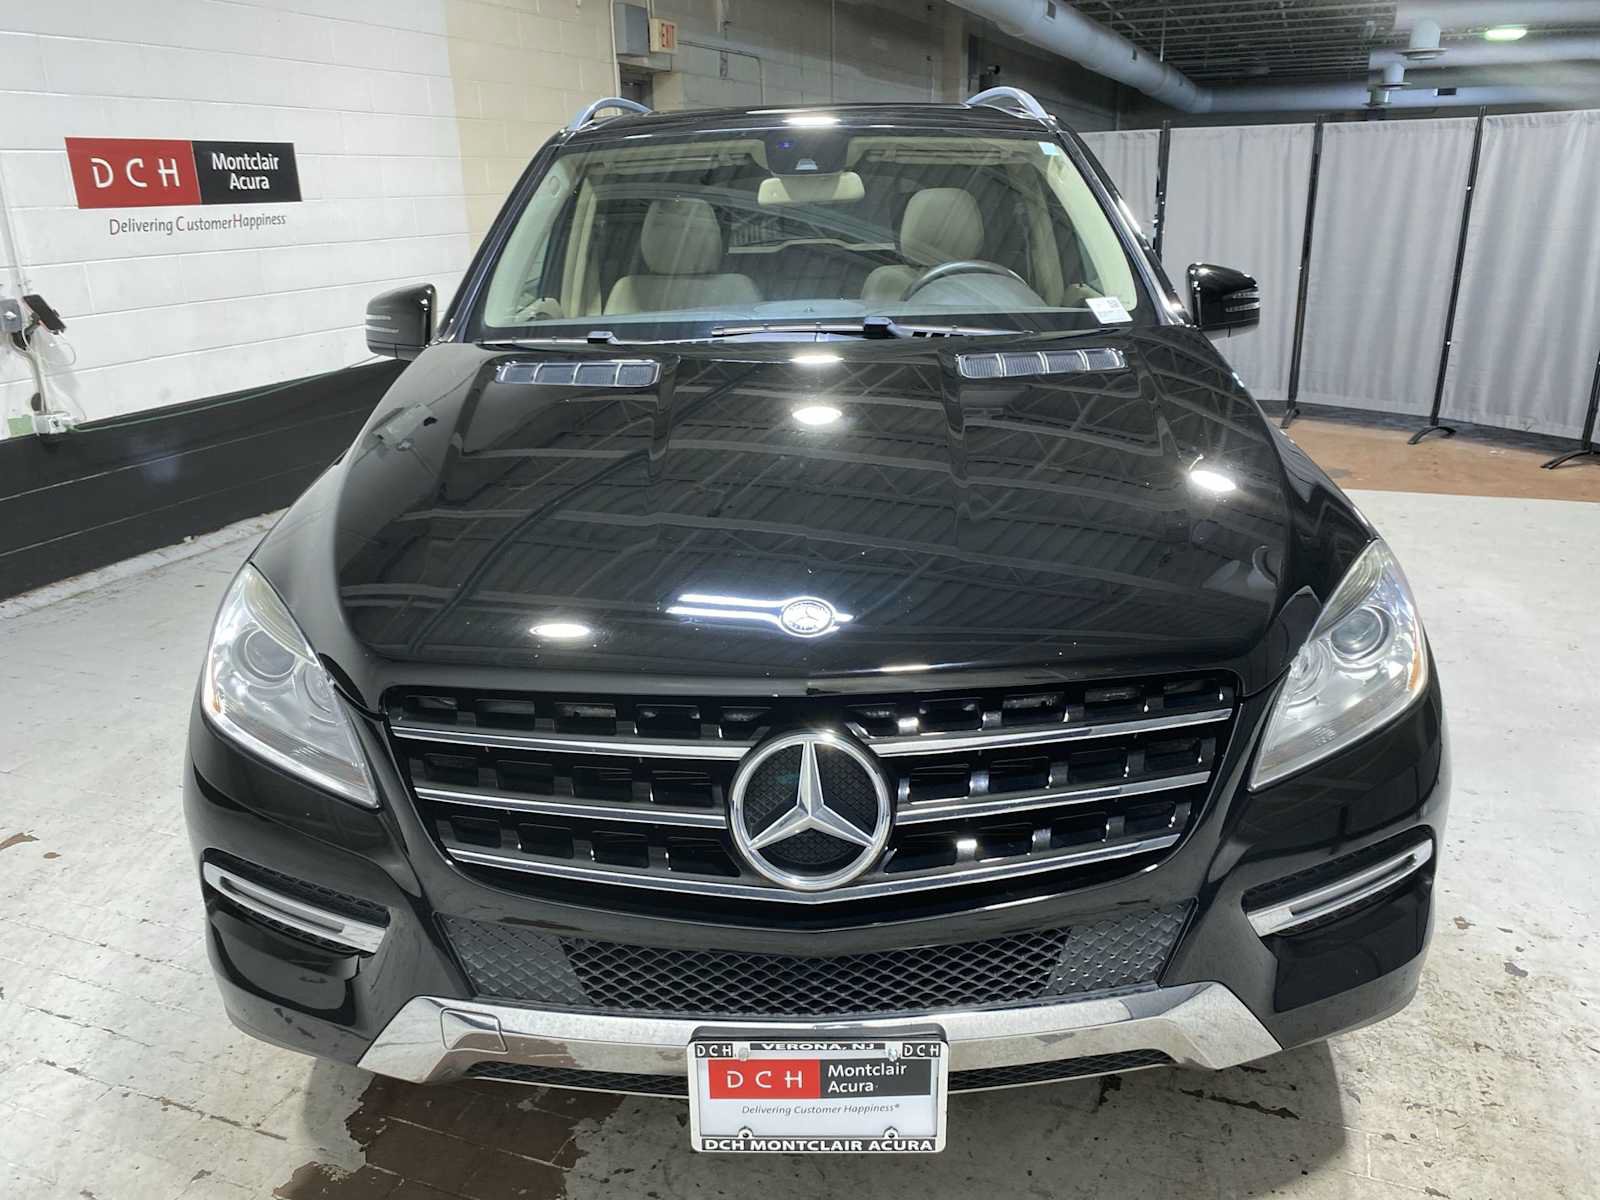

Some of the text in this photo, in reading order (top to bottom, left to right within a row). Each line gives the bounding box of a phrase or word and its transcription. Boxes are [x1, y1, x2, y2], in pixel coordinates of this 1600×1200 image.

[661, 23, 674, 48] EXIT
[211, 152, 280, 171] Montclair
[229, 172, 270, 190] Acura
[109, 217, 173, 236] Delivering
[761, 1043, 847, 1051] VERONA,
[827, 1062, 908, 1077] Montclair
[827, 1080, 874, 1093] Acura
[741, 1104, 792, 1116] Delivering
[794, 1105, 842, 1114] Customer
[704, 1139, 933, 1151] DCH MONTCLAIR ACURA
